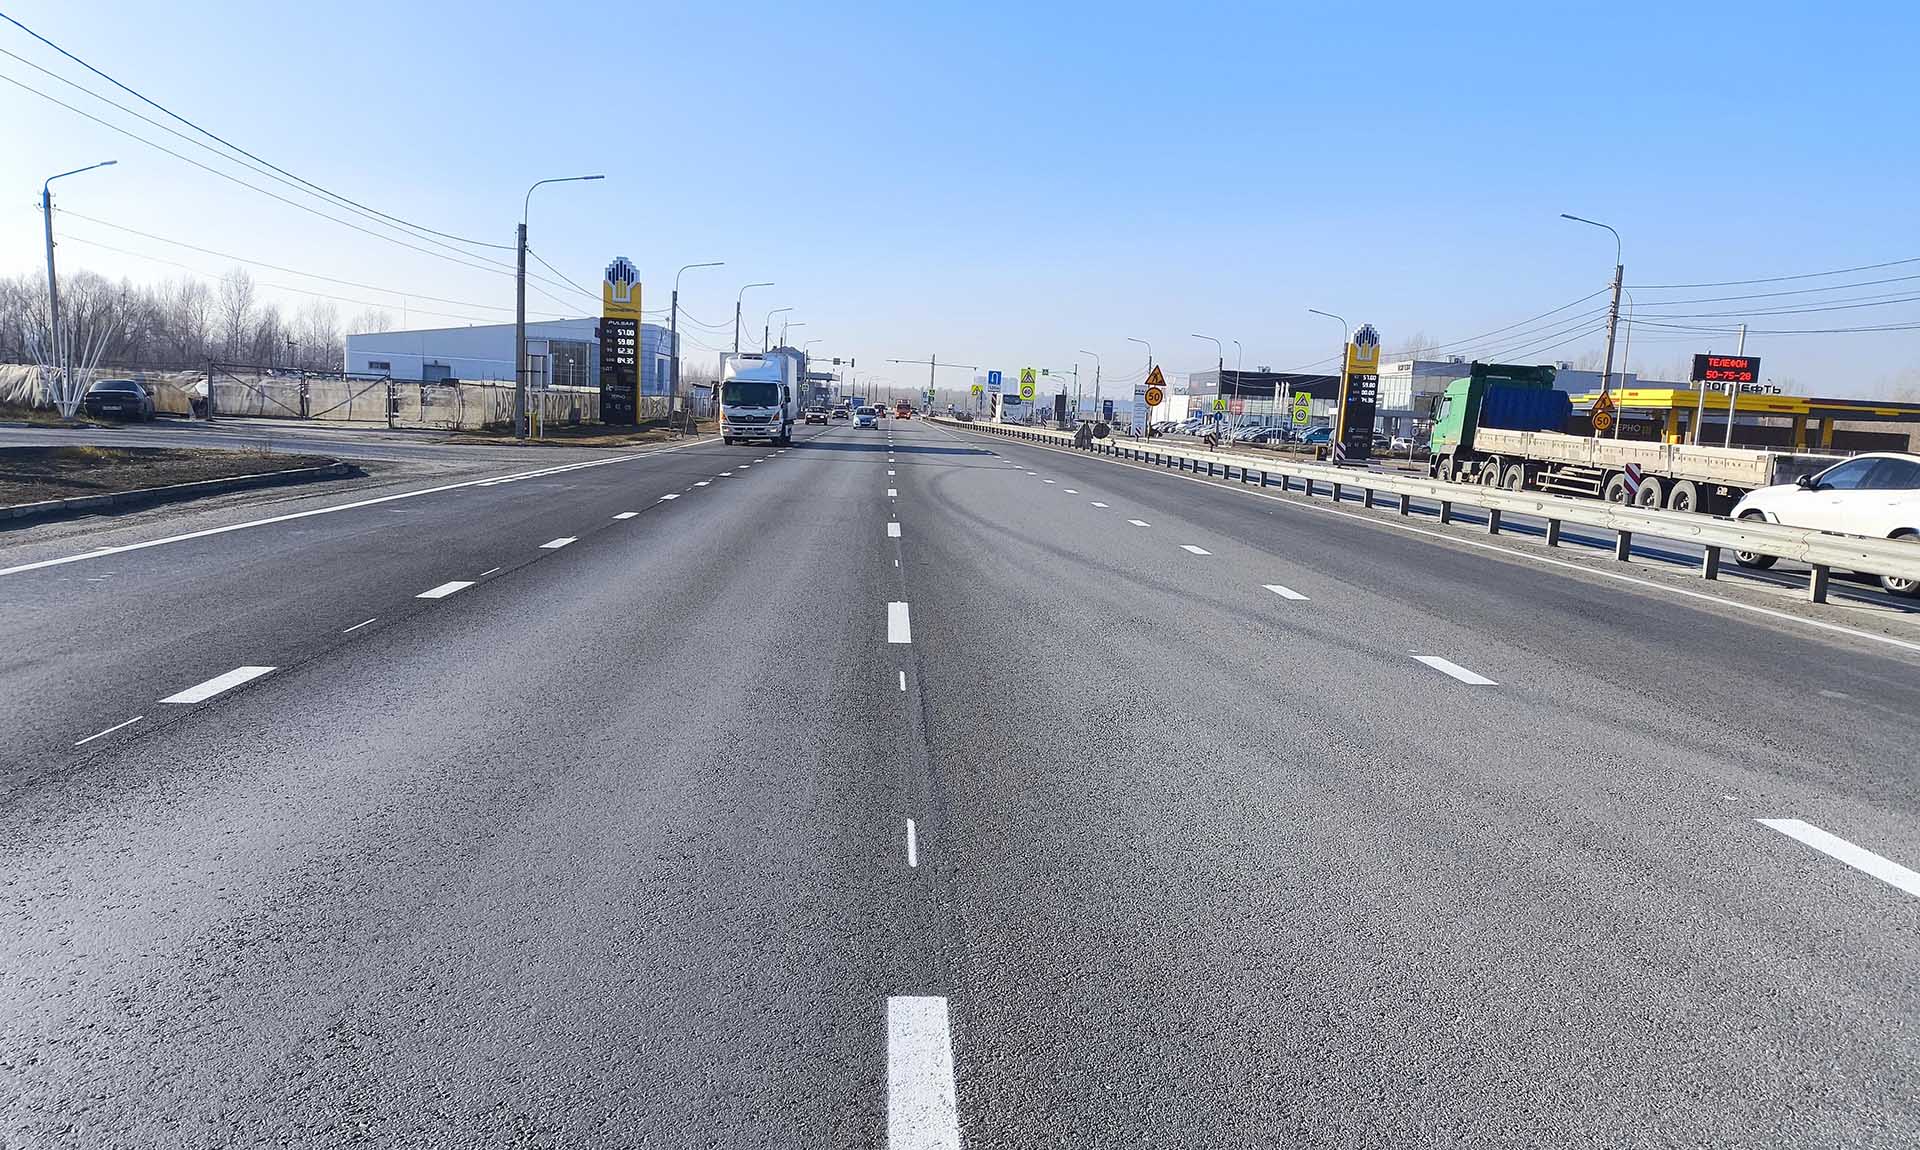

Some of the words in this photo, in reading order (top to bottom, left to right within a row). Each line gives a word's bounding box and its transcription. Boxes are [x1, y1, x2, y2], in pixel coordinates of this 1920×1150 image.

[617, 328, 635, 336] 57.00
[617, 347, 634, 355] 62.30
[616, 356, 634, 365] 84.35
[1708, 358, 1748, 368] ТЕЛЕФОН
[1706, 371, 1752, 380] 50-75-28
[1148, 392, 1160, 401] 50
[1597, 417, 1609, 426] 50
